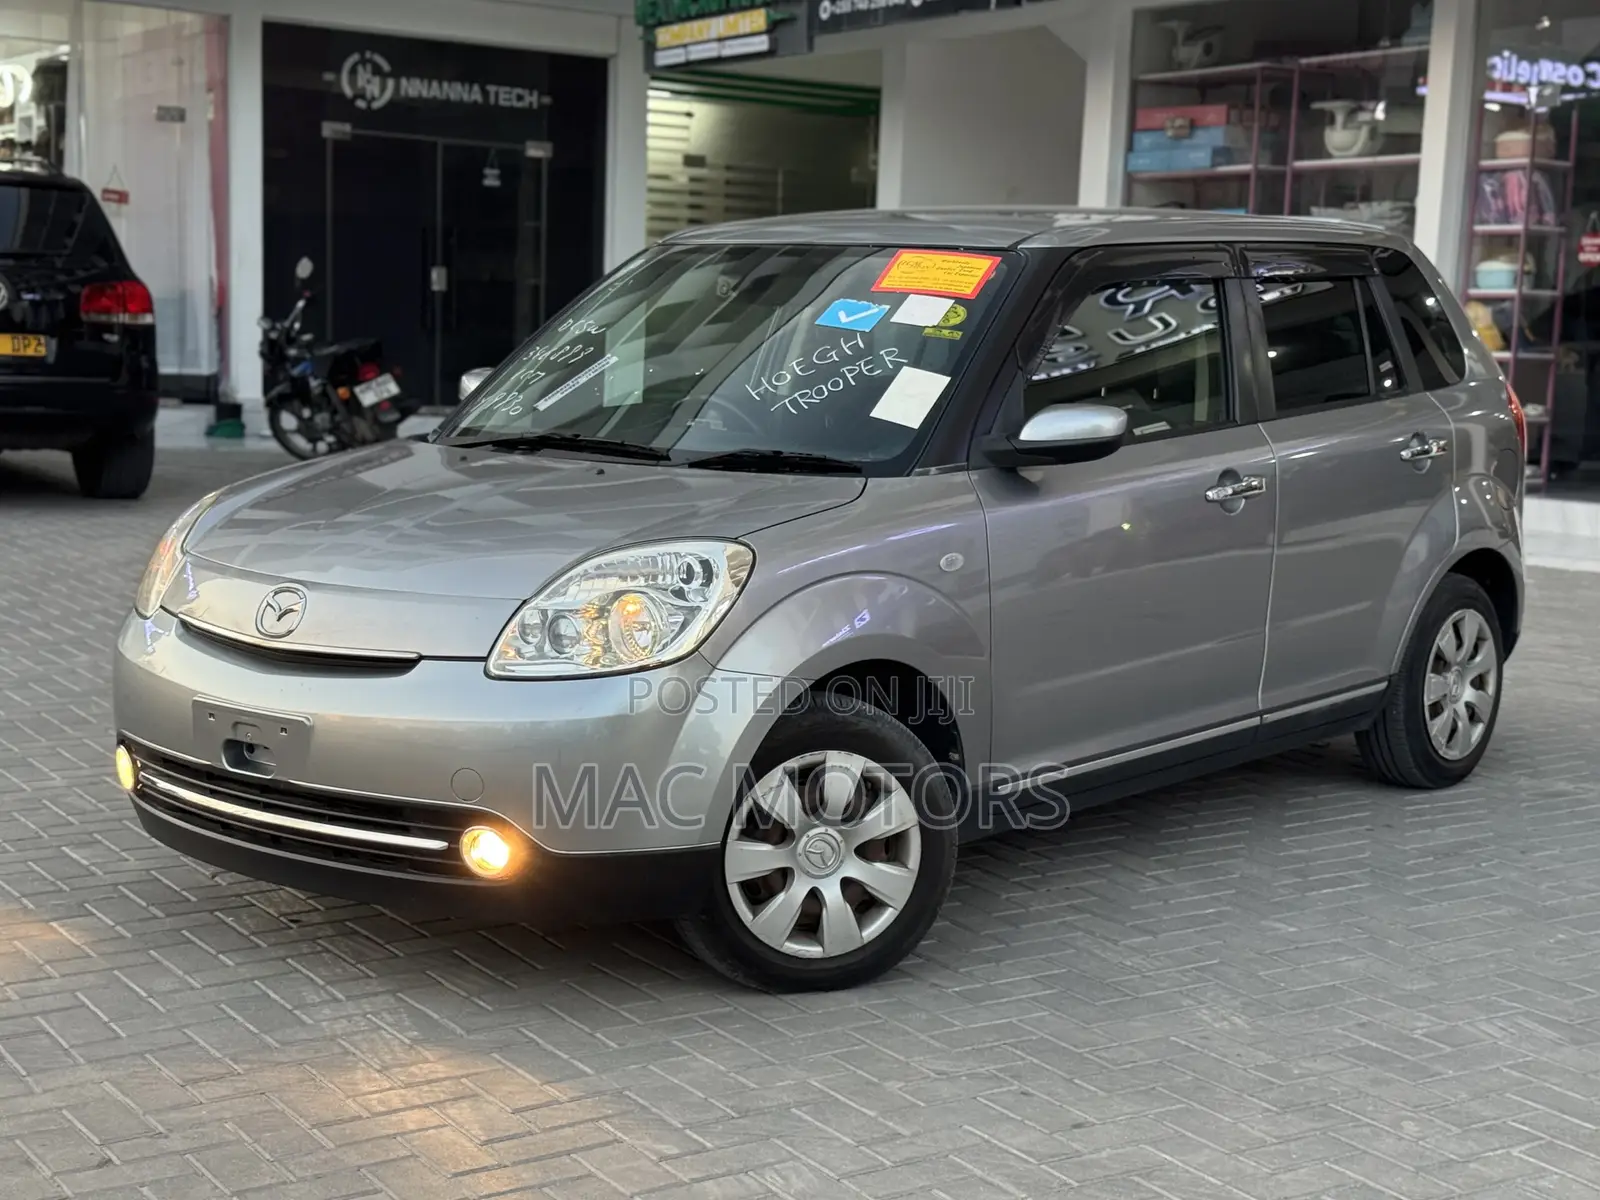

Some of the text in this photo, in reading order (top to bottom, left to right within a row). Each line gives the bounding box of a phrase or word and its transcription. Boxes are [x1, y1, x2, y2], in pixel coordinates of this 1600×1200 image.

[400, 76, 539, 110] NNANNA TECH
[745, 332, 864, 401] HOEGH
[770, 347, 909, 415] TROOPER
